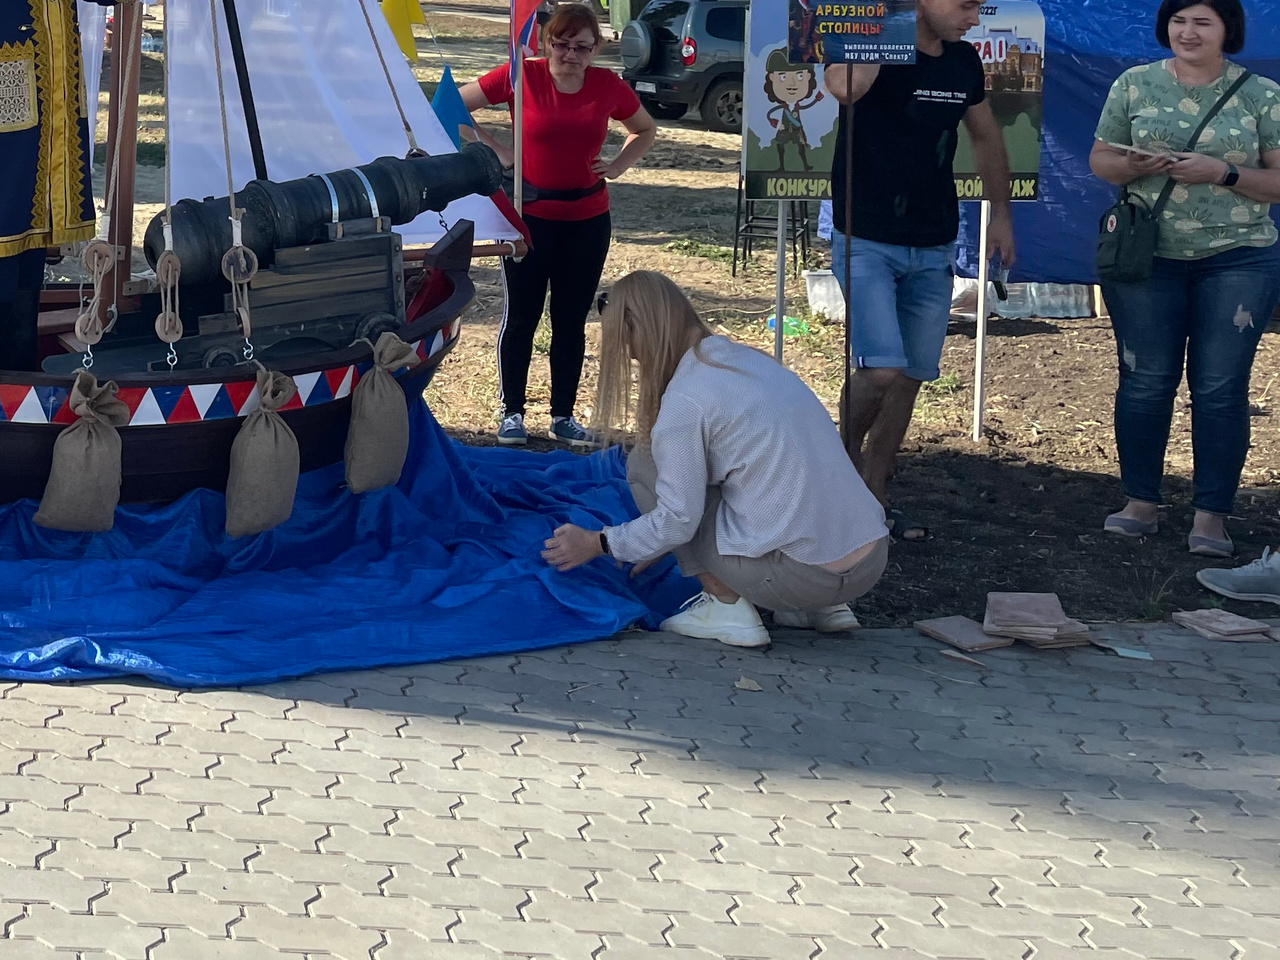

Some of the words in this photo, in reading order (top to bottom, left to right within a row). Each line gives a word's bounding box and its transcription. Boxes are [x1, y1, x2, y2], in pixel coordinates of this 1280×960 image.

[815, 3, 885, 17] АРБУЗНОЙ
[978, 6, 998, 16] 022г
[954, 176, 984, 197] ВОЙ
[1009, 179, 1036, 197] АЖ
